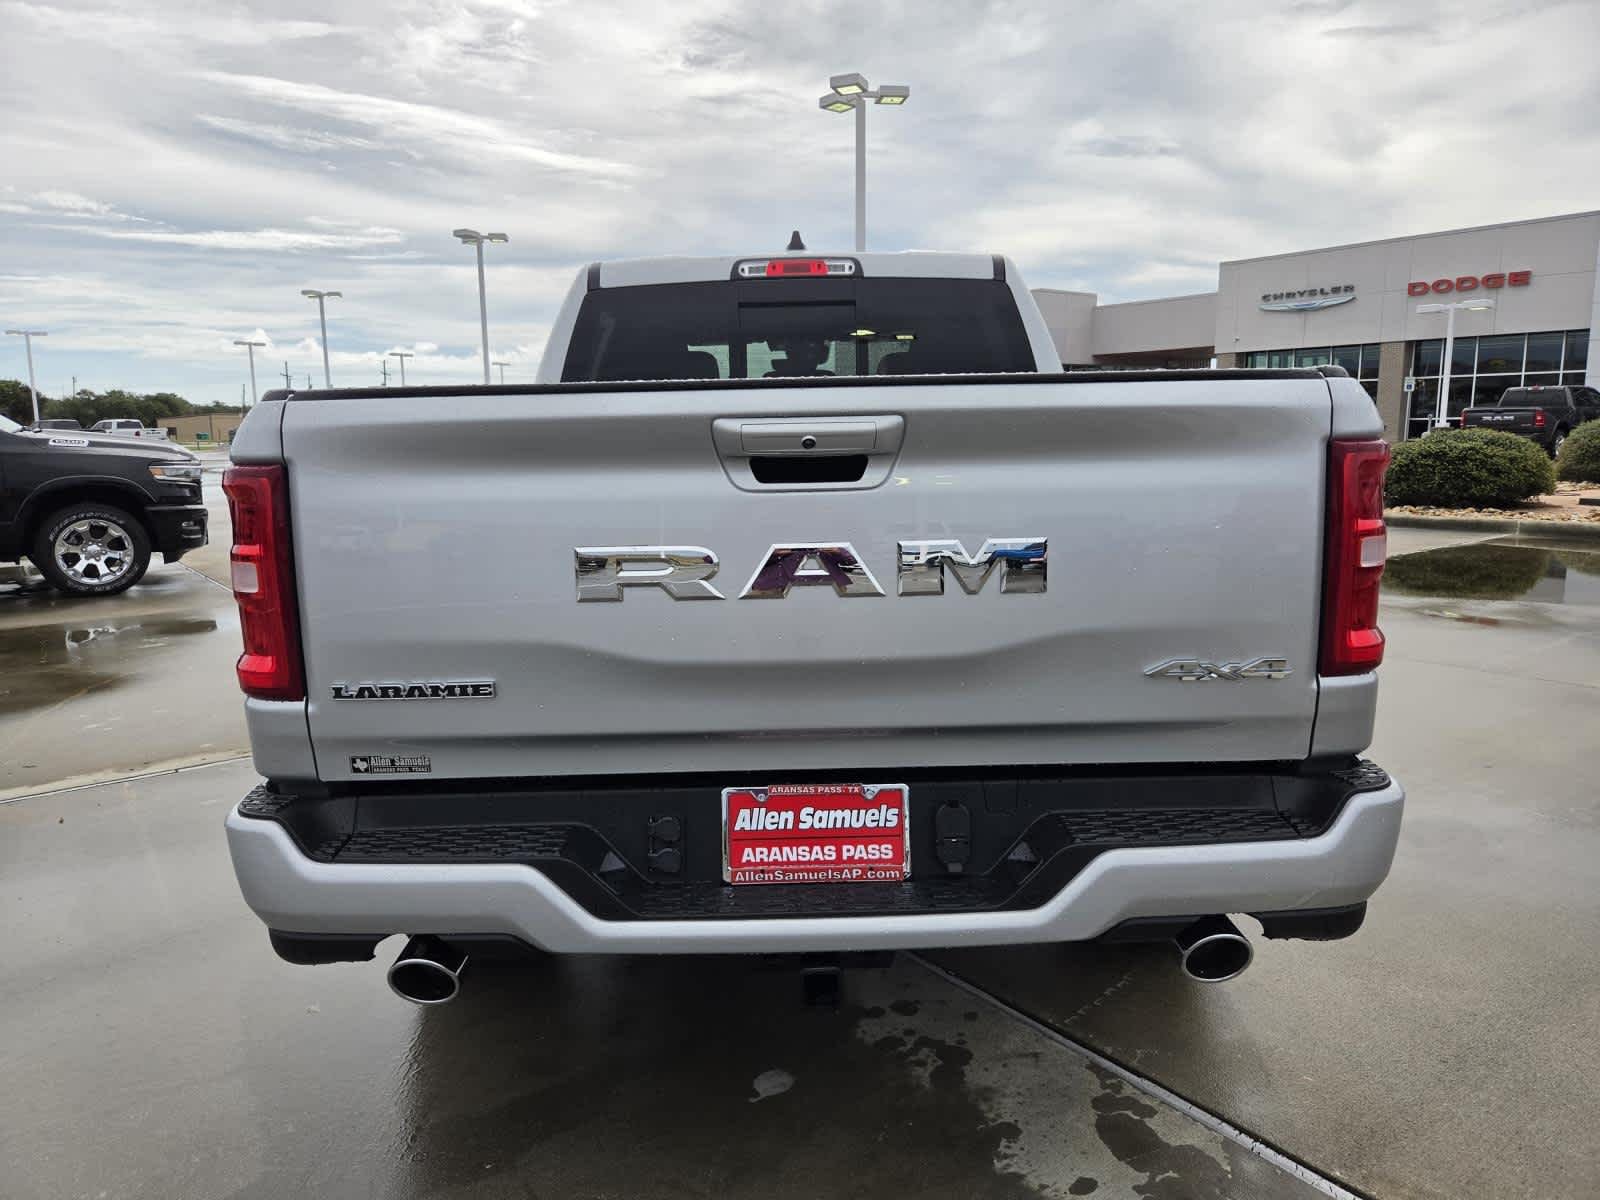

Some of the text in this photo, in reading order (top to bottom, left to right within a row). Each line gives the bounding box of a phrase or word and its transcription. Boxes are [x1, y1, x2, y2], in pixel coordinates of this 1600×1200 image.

[1262, 284, 1355, 302] CHRYSLER
[1407, 270, 1532, 297] DODGE
[574, 537, 1048, 602] RAM
[331, 680, 497, 701] LARAMIE
[371, 755, 430, 766] Allen Samuels
[771, 786, 815, 794] ARANSAS
[848, 785, 860, 793] TX
[734, 804, 899, 831] Allen Samuels
[741, 844, 893, 863] ARANSAS PASS
[735, 868, 900, 882] AllenSamuelsAP.com
